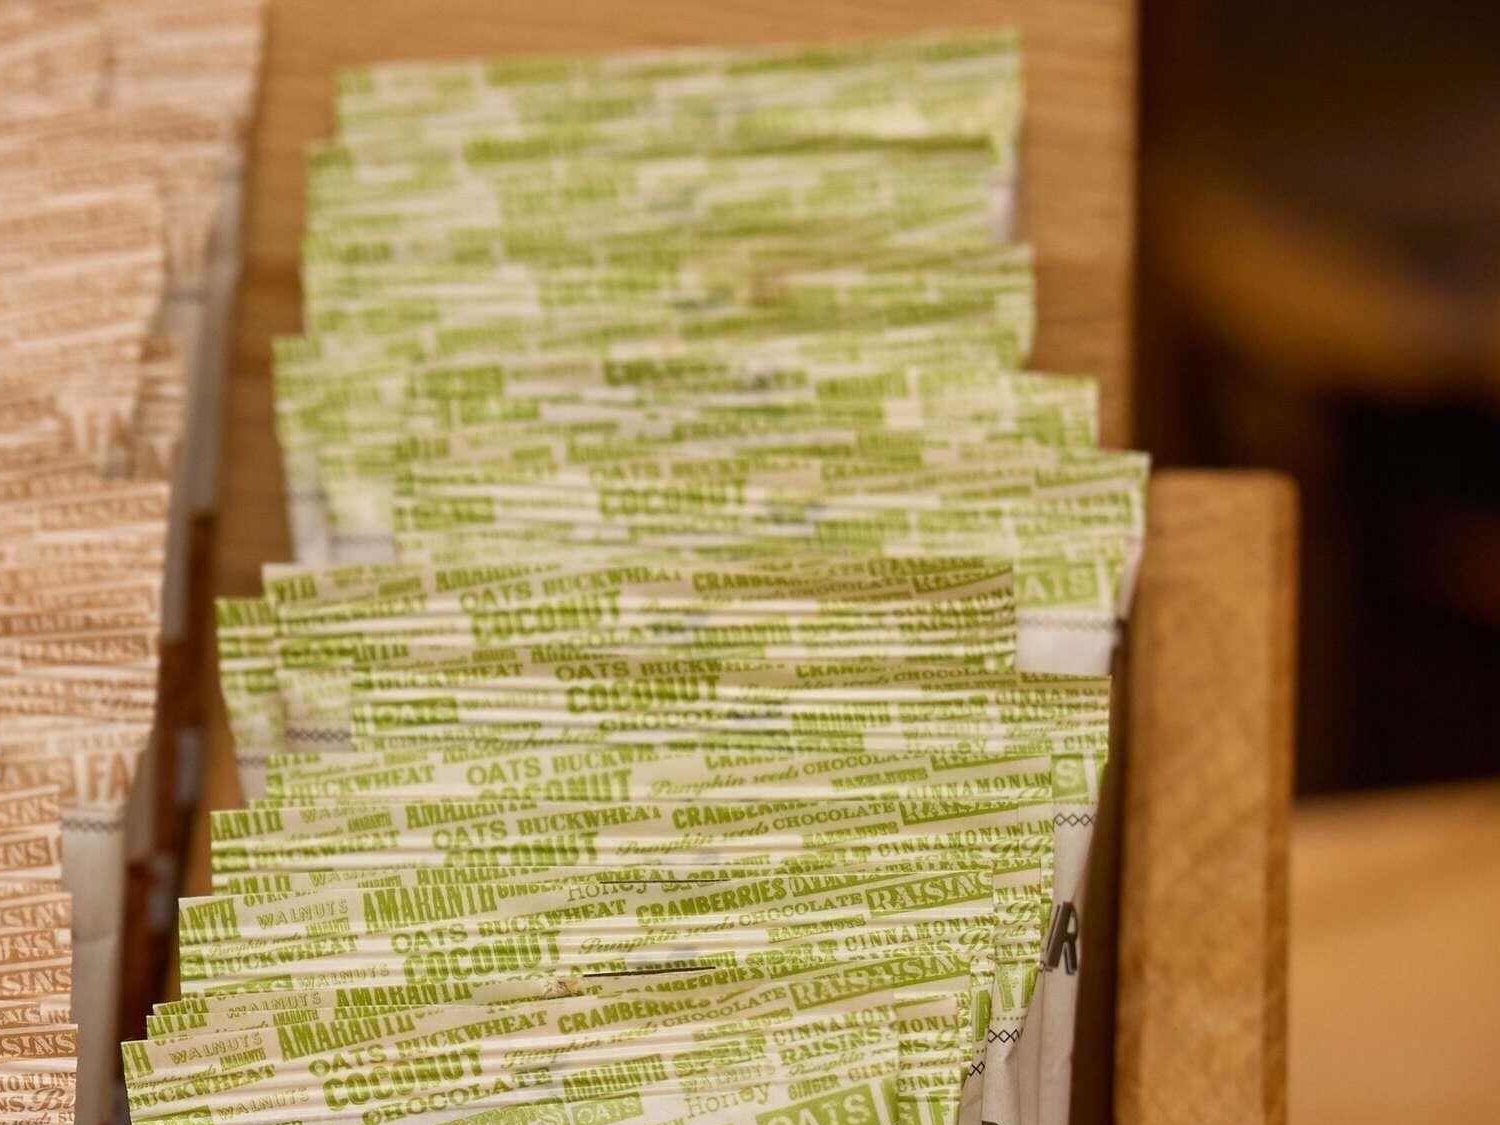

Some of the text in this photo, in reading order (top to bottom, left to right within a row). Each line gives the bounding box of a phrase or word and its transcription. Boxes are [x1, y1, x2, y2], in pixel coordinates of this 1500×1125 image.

[466, 757, 542, 786] OATS
[517, 805, 663, 837] BUCKWHEAT
[772, 801, 897, 831] CHOCOLATE
[432, 820, 509, 850] OATS
[257, 899, 349, 929] WALNUTS
[478, 900, 627, 937] BUCKWHEAT
[635, 878, 788, 927] CRANBERRIES
[738, 892, 865, 927] CHOCOLATE
[391, 922, 469, 953] OATS
[843, 916, 966, 952] CINNAMON
[402, 930, 562, 984] COCONUT
[662, 986, 788, 1027] CHOCOLATE
[168, 1032, 263, 1065] WALNUTS
[396, 1010, 549, 1058] BUCKWHEAT
[780, 1027, 883, 1066] RAISINS
[308, 1043, 389, 1077] OATS
[323, 1046, 484, 1111] COCONUT
[787, 1074, 840, 1101] GINGER
[217, 1088, 310, 1119] WALNUTS
[576, 1098, 637, 1125] OATS
[685, 1084, 772, 1119] Honey
